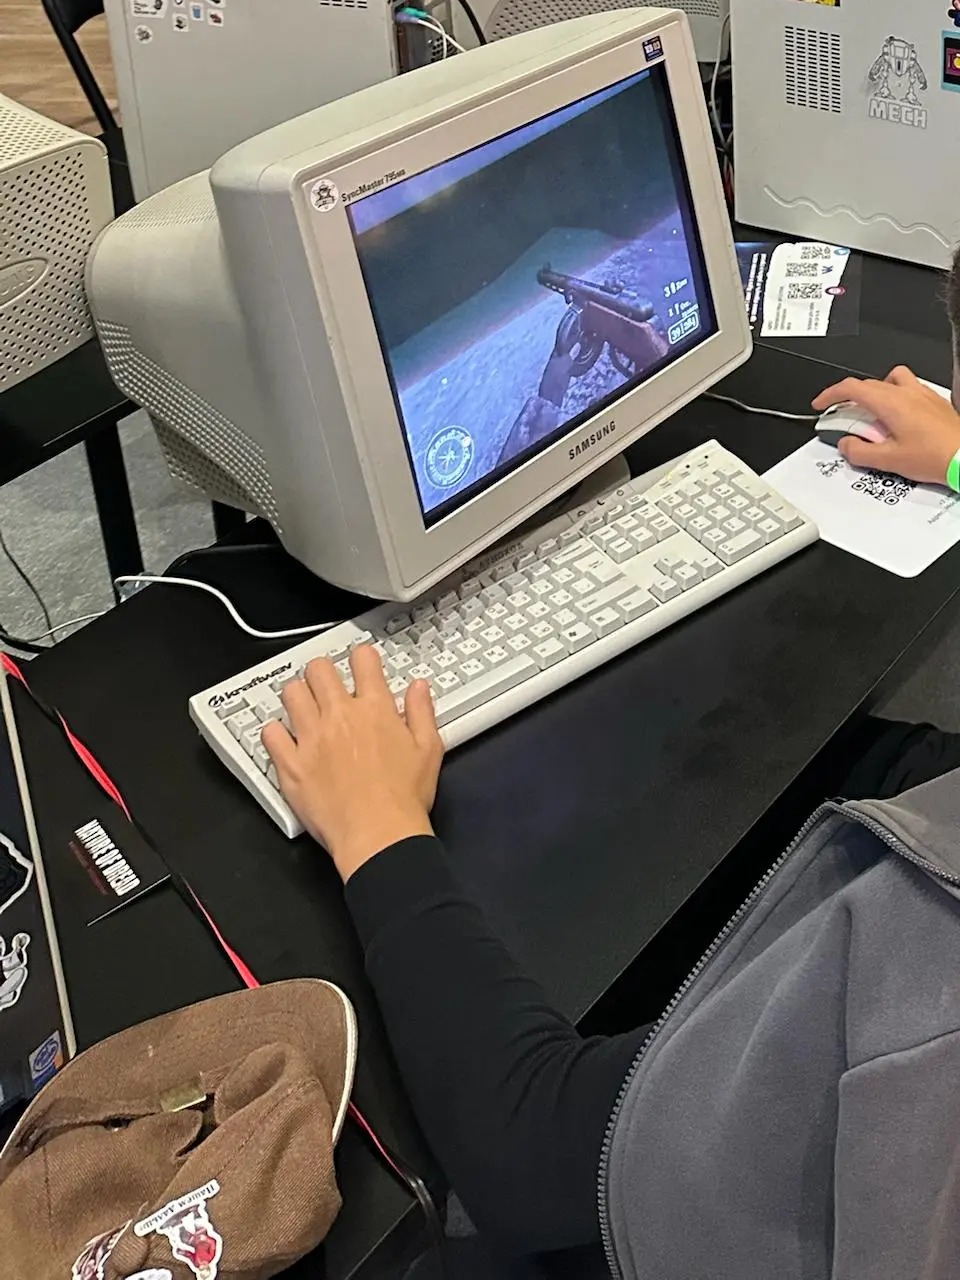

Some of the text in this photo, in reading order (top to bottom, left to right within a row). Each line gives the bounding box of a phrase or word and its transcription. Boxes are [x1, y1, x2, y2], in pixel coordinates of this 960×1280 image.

[868, 98, 928, 130] MECH
[341, 177, 386, 203] SyncMaster
[568, 420, 617, 461] SAMSUNG
[102, 858, 141, 897] DREAD
